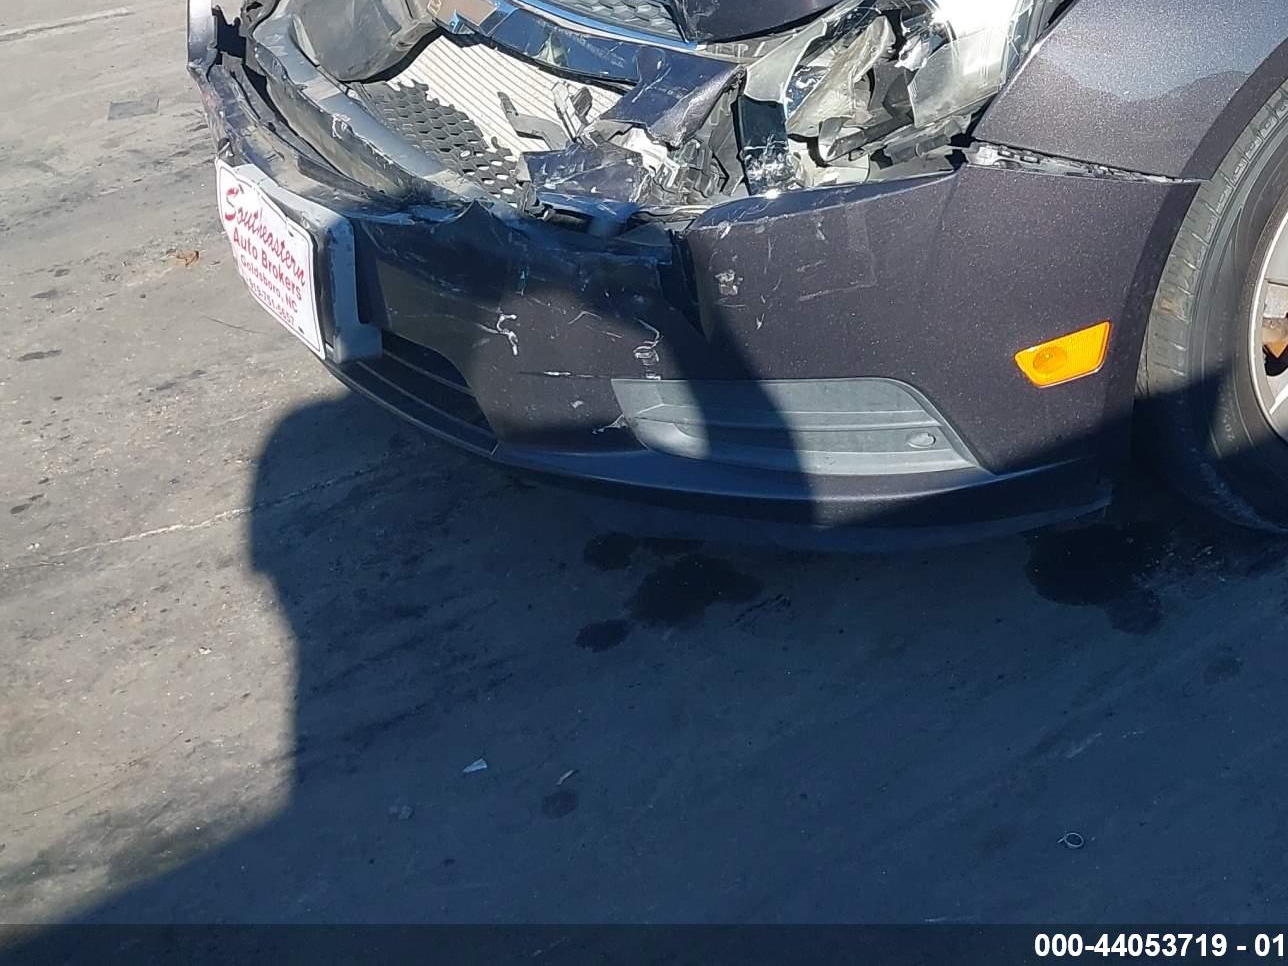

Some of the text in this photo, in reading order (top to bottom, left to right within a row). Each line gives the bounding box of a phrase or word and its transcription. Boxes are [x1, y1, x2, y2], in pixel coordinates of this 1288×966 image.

[224, 187, 306, 286] Southeastern
[233, 227, 303, 302] Auto Brokers
[285, 293, 298, 314] NC
